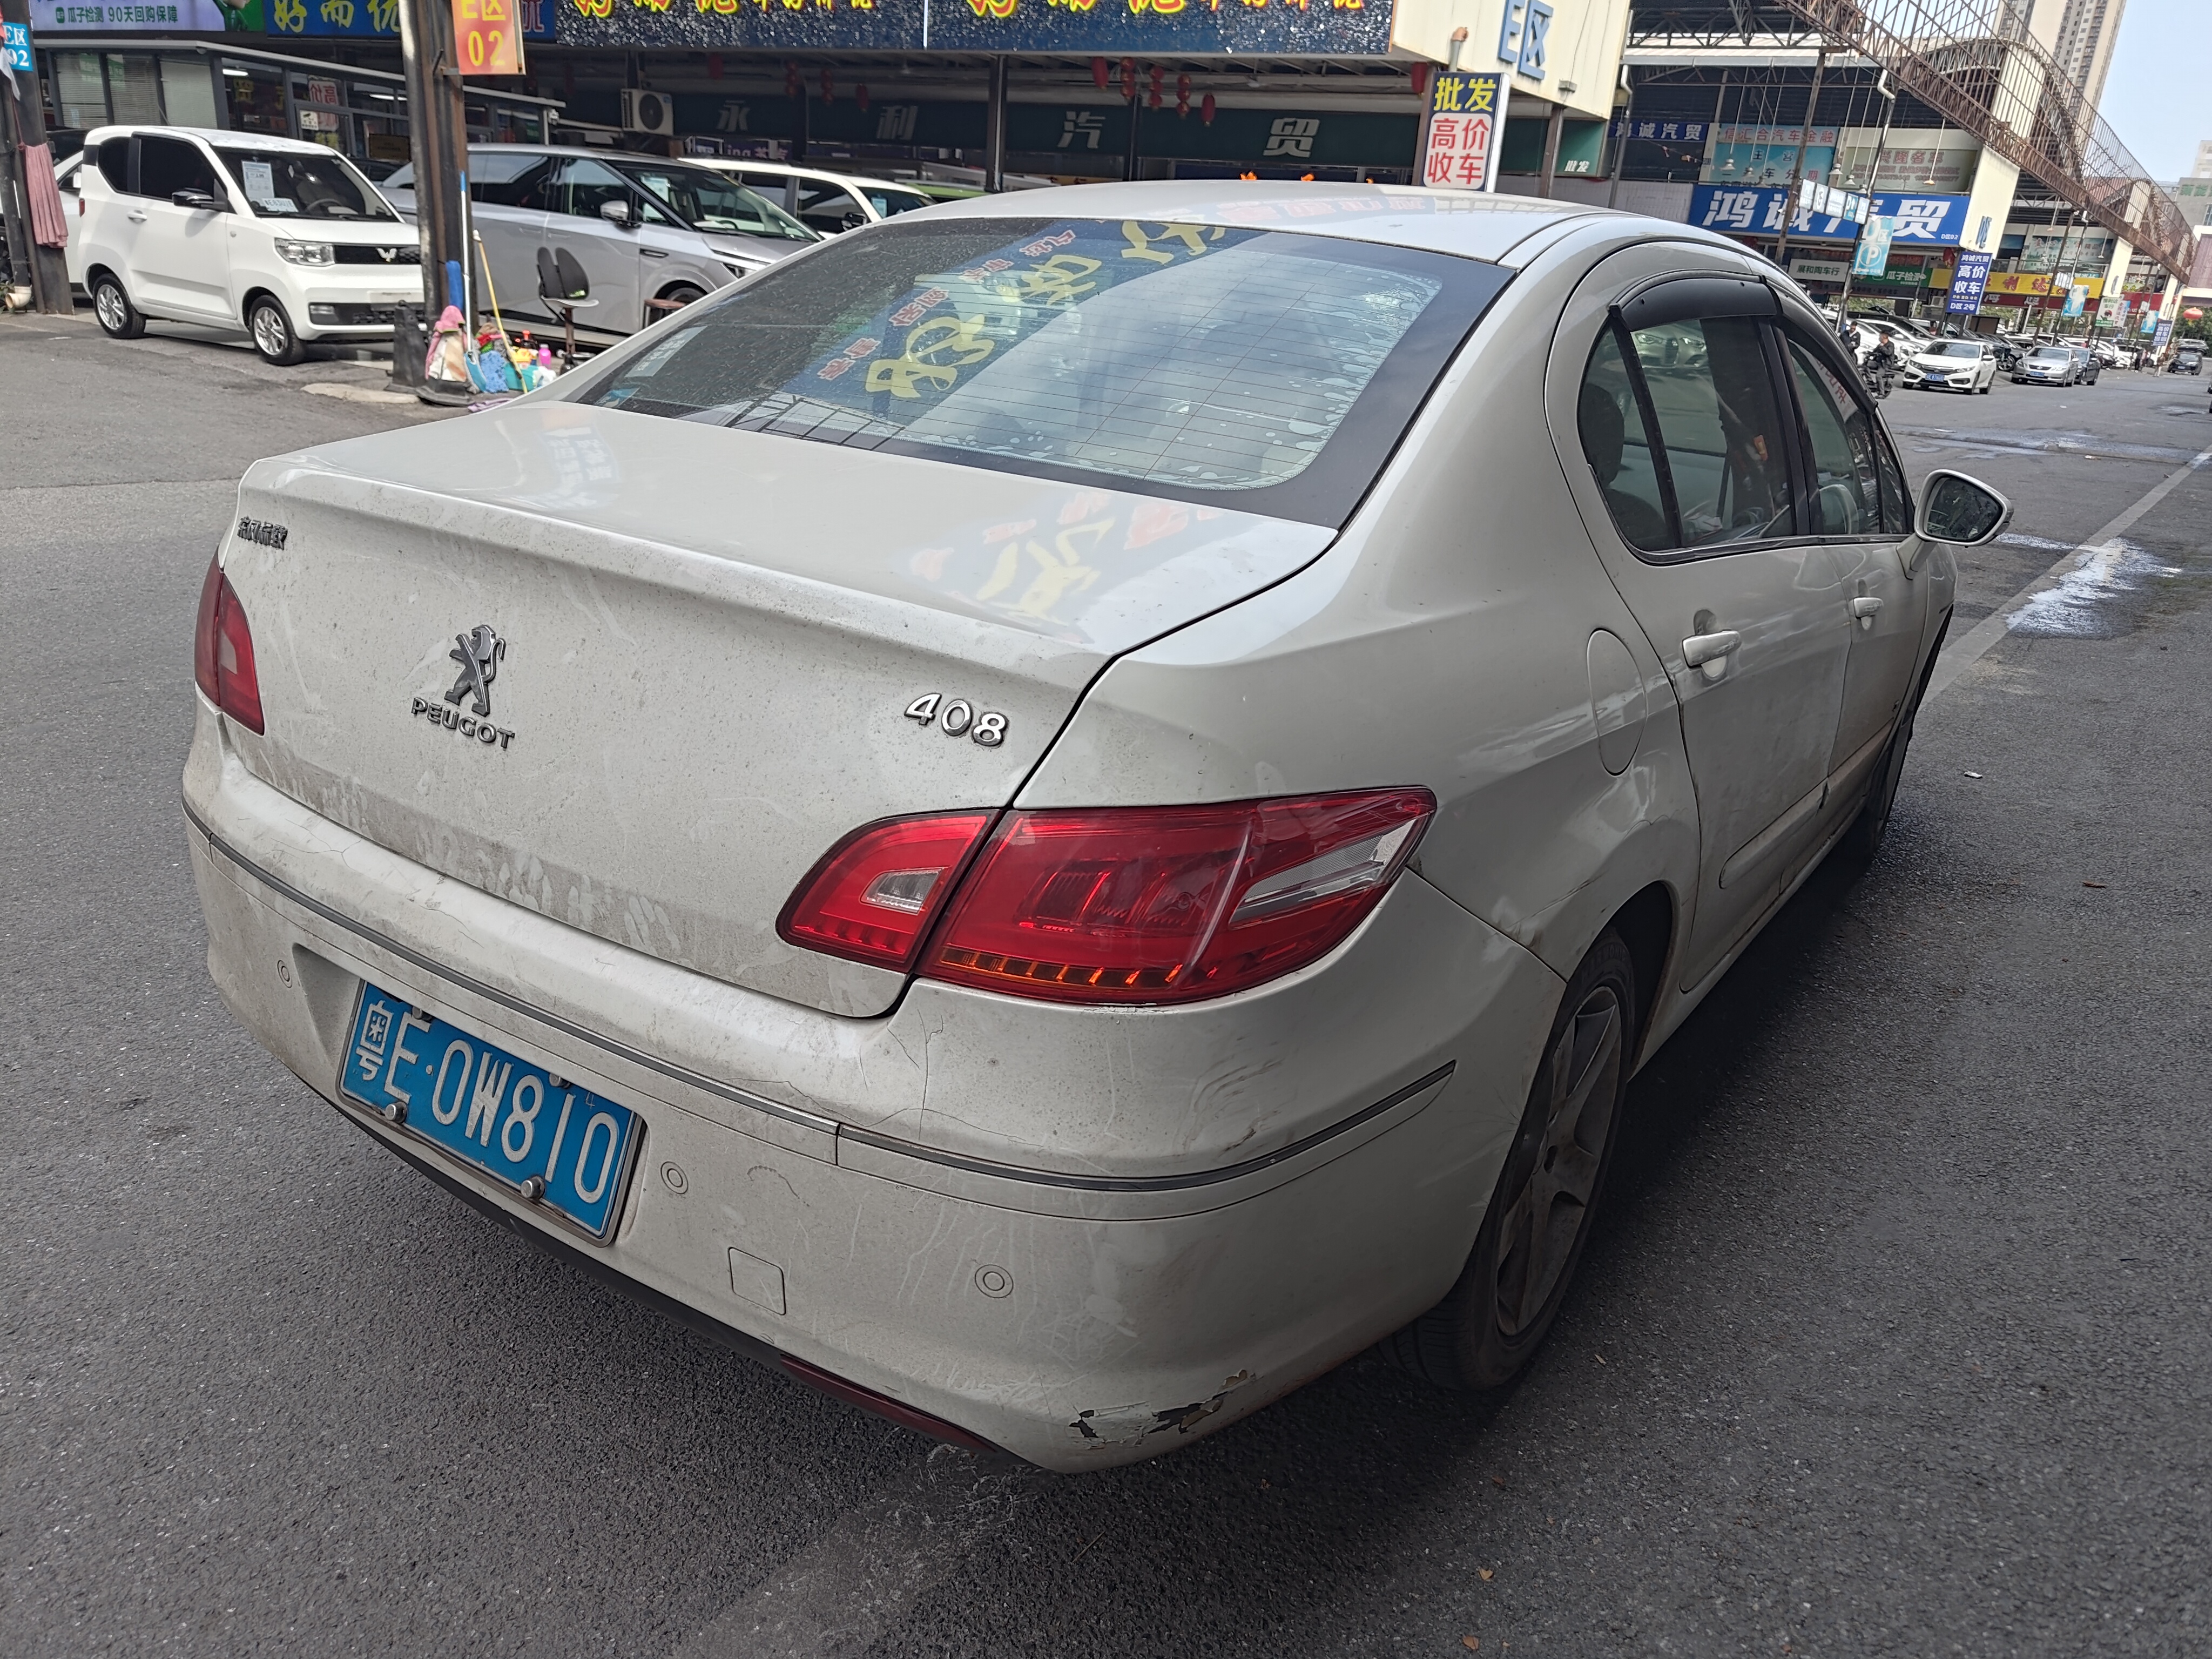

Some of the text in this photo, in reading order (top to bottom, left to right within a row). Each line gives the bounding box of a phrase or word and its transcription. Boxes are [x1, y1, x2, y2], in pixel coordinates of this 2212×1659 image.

[68, 6, 104, 23] 瓜子检测
[109, 5, 178, 23] 90天回购保障
[2, 25, 27, 46] E区
[468, 30, 507, 66] 02
[1499, 0, 1554, 80] E区
[1434, 77, 1496, 112] 批发
[1431, 118, 1489, 151] 高价
[1427, 152, 1483, 185] 收车
[1564, 160, 1590, 173] 批发
[1954, 281, 1981, 294] 收车
[1958, 265, 1985, 279] 高价
[411, 697, 515, 750] PEUGOT
[904, 692, 1010, 747] 408
